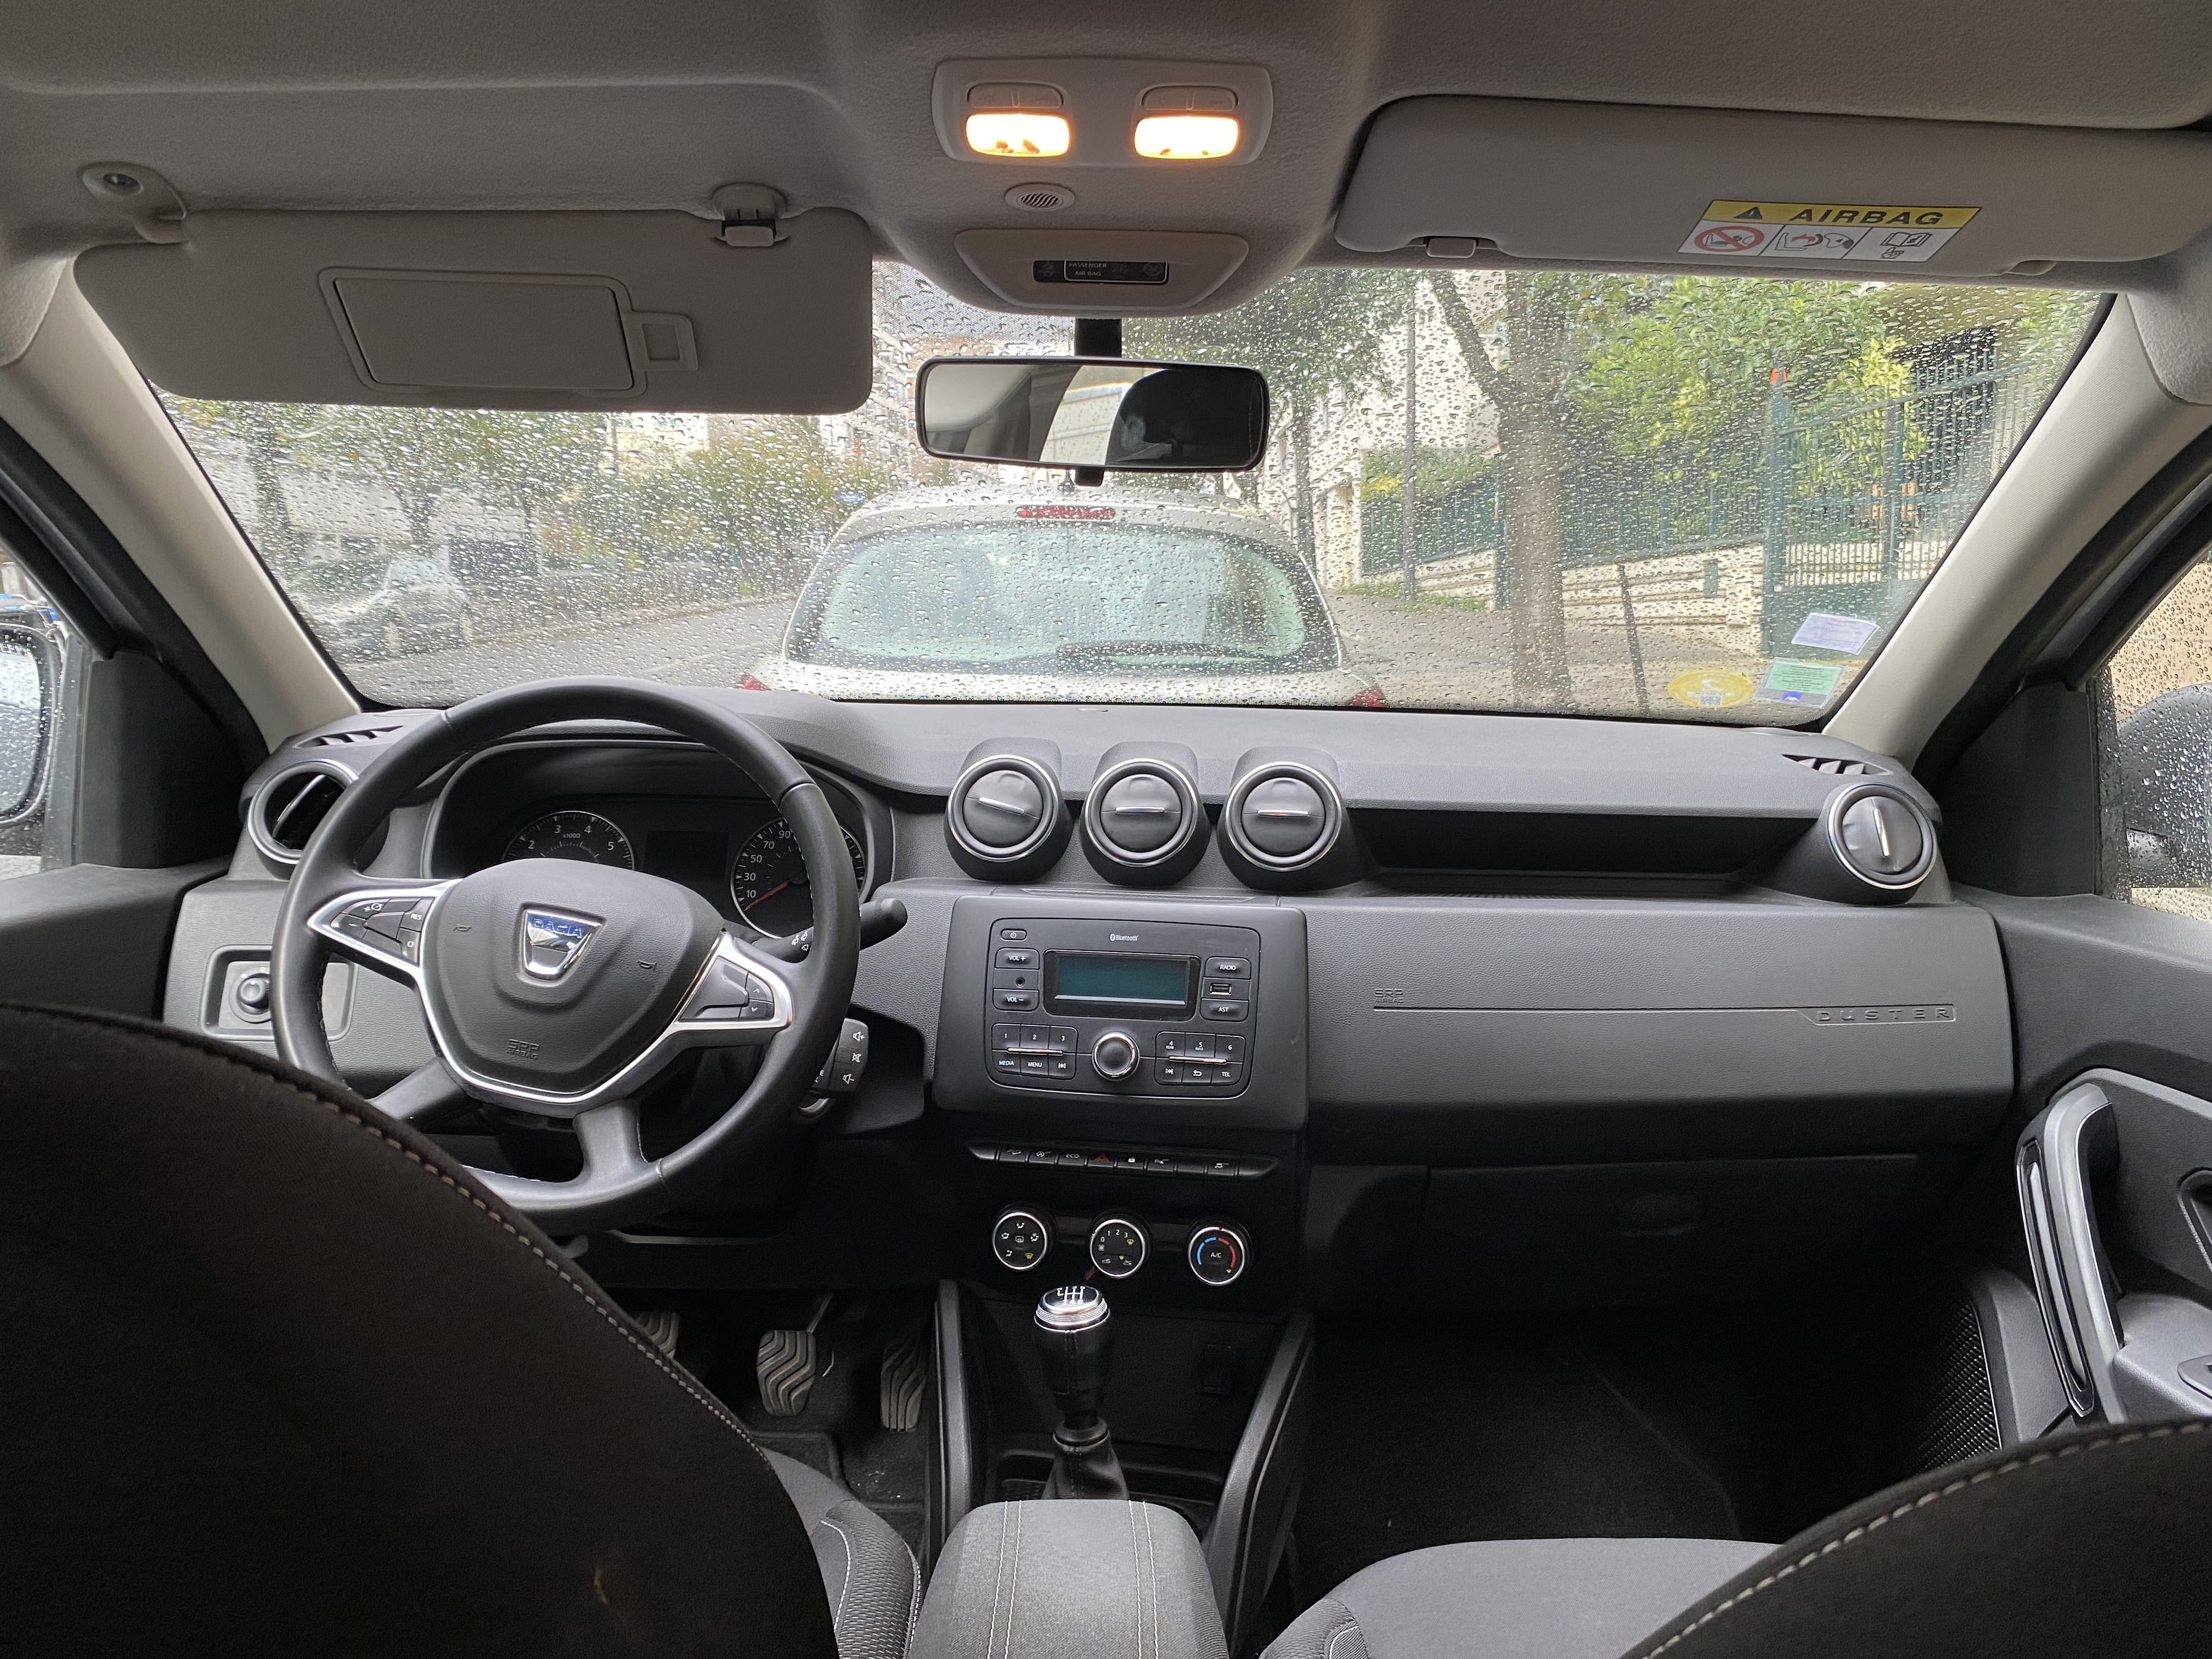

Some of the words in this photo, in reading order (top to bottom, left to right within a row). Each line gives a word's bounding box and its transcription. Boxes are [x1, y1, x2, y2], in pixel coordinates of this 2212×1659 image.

[1788, 208, 1944, 225] AIRBAG
[554, 825, 561, 833] 3
[584, 825, 591, 834] 4
[778, 830, 791, 839] 90
[528, 840, 534, 849] 2
[607, 841, 615, 850] 5
[763, 840, 775, 849] 70
[750, 854, 763, 863] 50
[744, 872, 756, 881] 30
[746, 890, 756, 898] 10
[532, 918, 583, 939] DACIA
[1817, 1007, 1949, 1021] DUSTER
